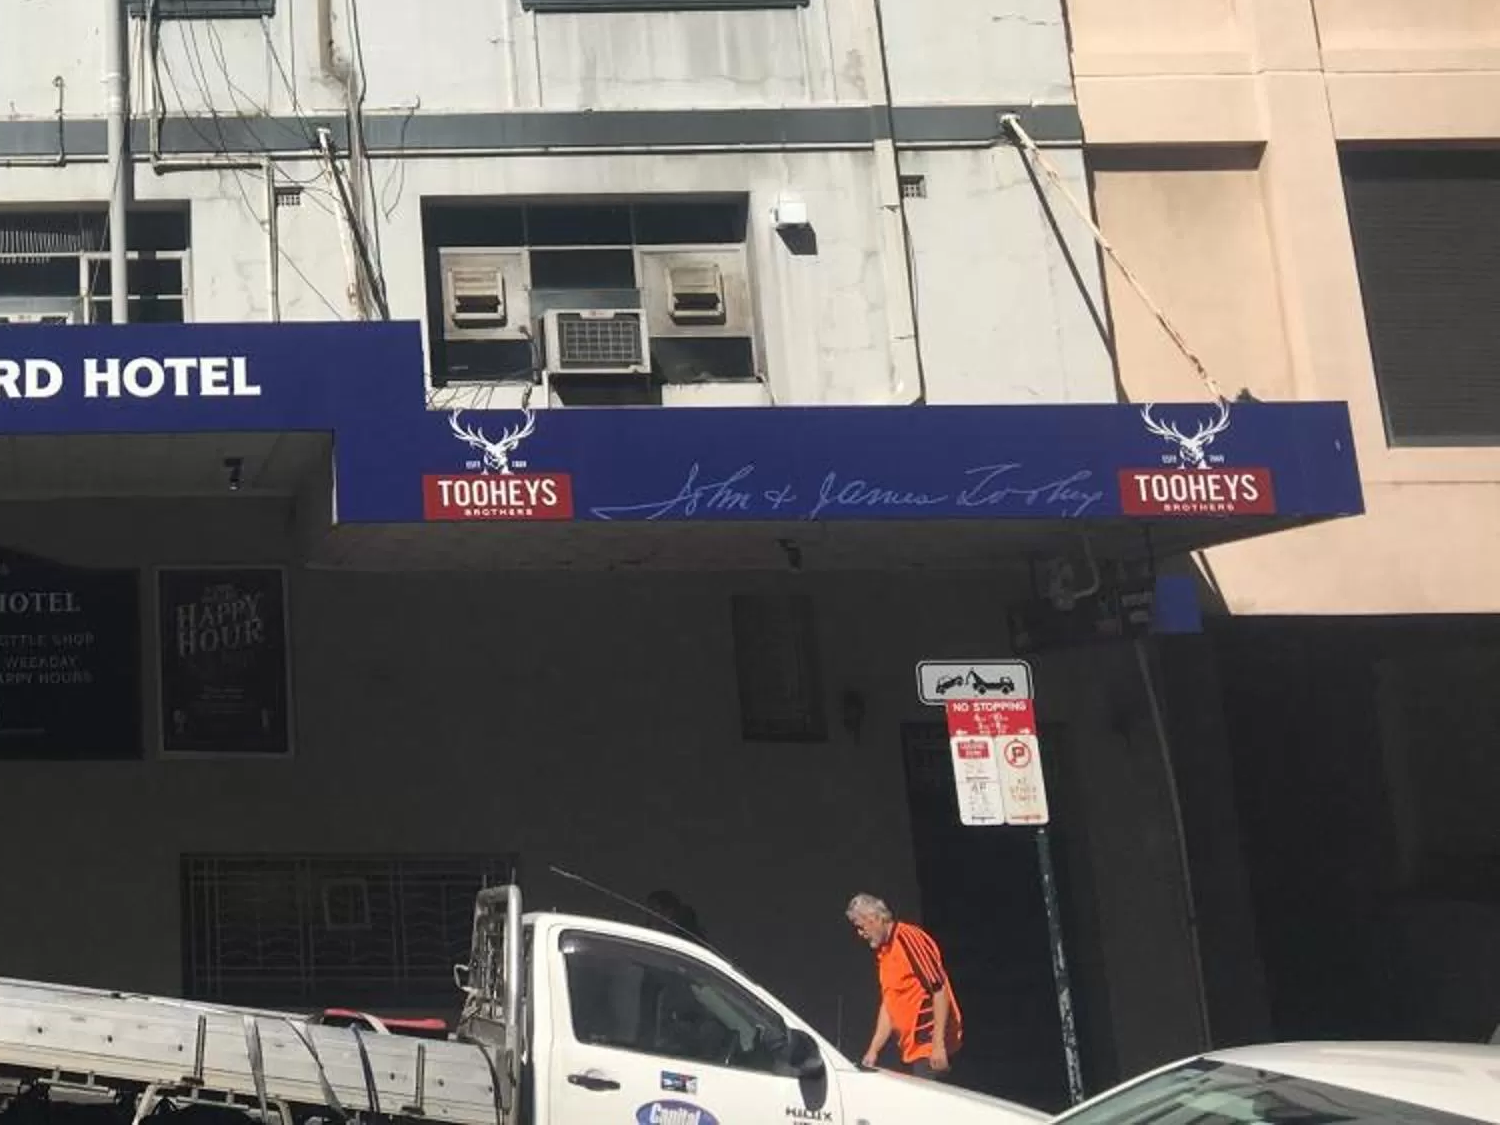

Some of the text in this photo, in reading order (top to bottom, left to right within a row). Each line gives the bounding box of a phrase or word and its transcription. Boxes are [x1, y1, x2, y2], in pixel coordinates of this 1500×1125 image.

[84, 357, 262, 398] HOTEL
[438, 479, 557, 507] TOOHEYS
[1134, 474, 1259, 502] TOOHEYS
[464, 508, 533, 516] BROTHERS
[1164, 503, 1235, 512] BROTHERS
[177, 589, 265, 630] HAPPY
[52, 632, 97, 648] SHOP
[178, 617, 266, 658] HOUR
[5, 654, 79, 669] WEEKDAY
[38, 671, 95, 685] HOURS
[952, 701, 1027, 712] NO STOPPING
